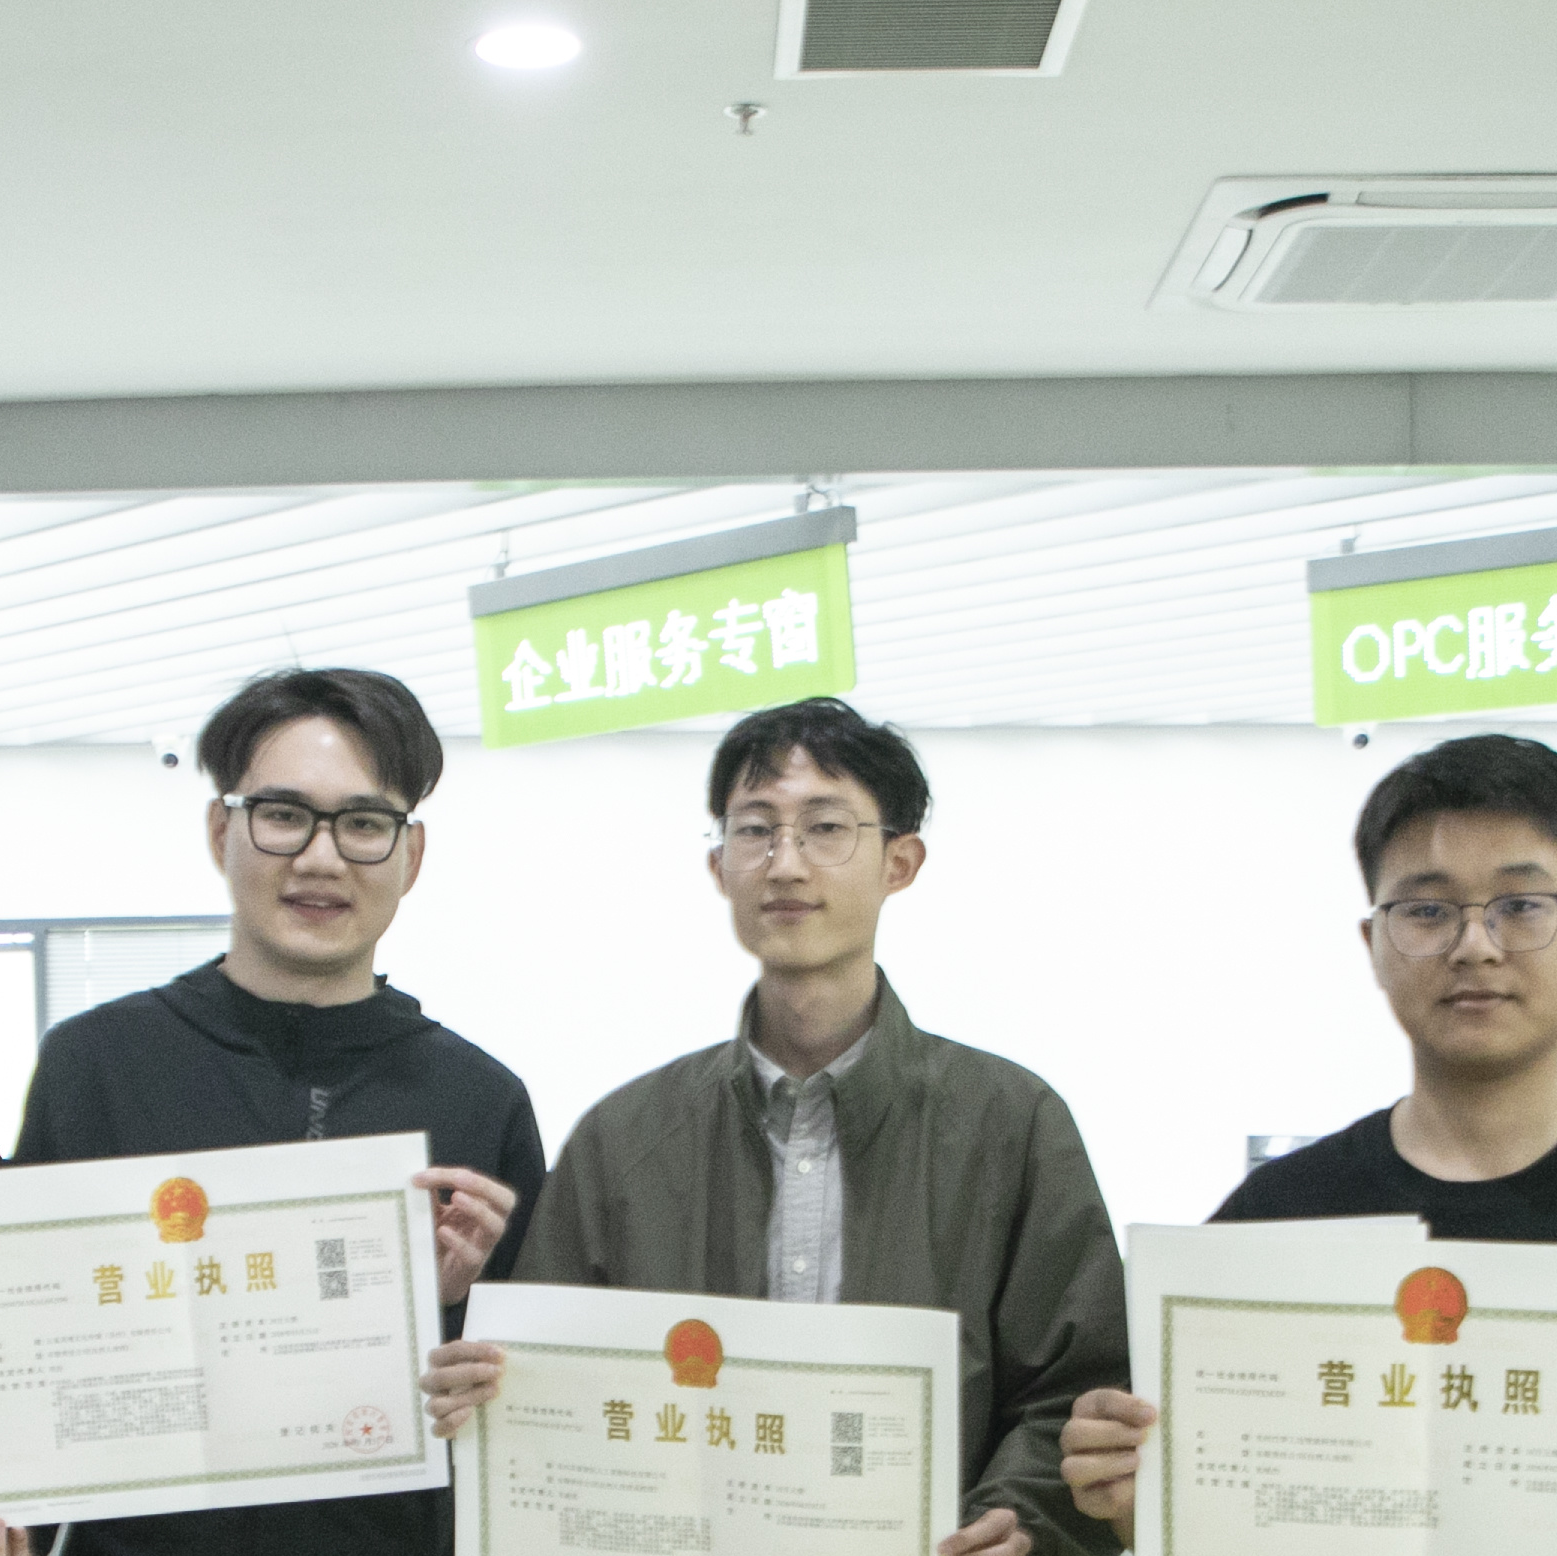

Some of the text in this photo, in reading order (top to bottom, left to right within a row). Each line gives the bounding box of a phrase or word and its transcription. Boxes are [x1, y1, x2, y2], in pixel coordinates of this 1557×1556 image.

[502, 588, 818, 712] 企业服务专窗
[93, 1251, 276, 1305] 营业执照
[1317, 1359, 1540, 1414] 营业执照
[603, 1399, 785, 1454] 营业执照
